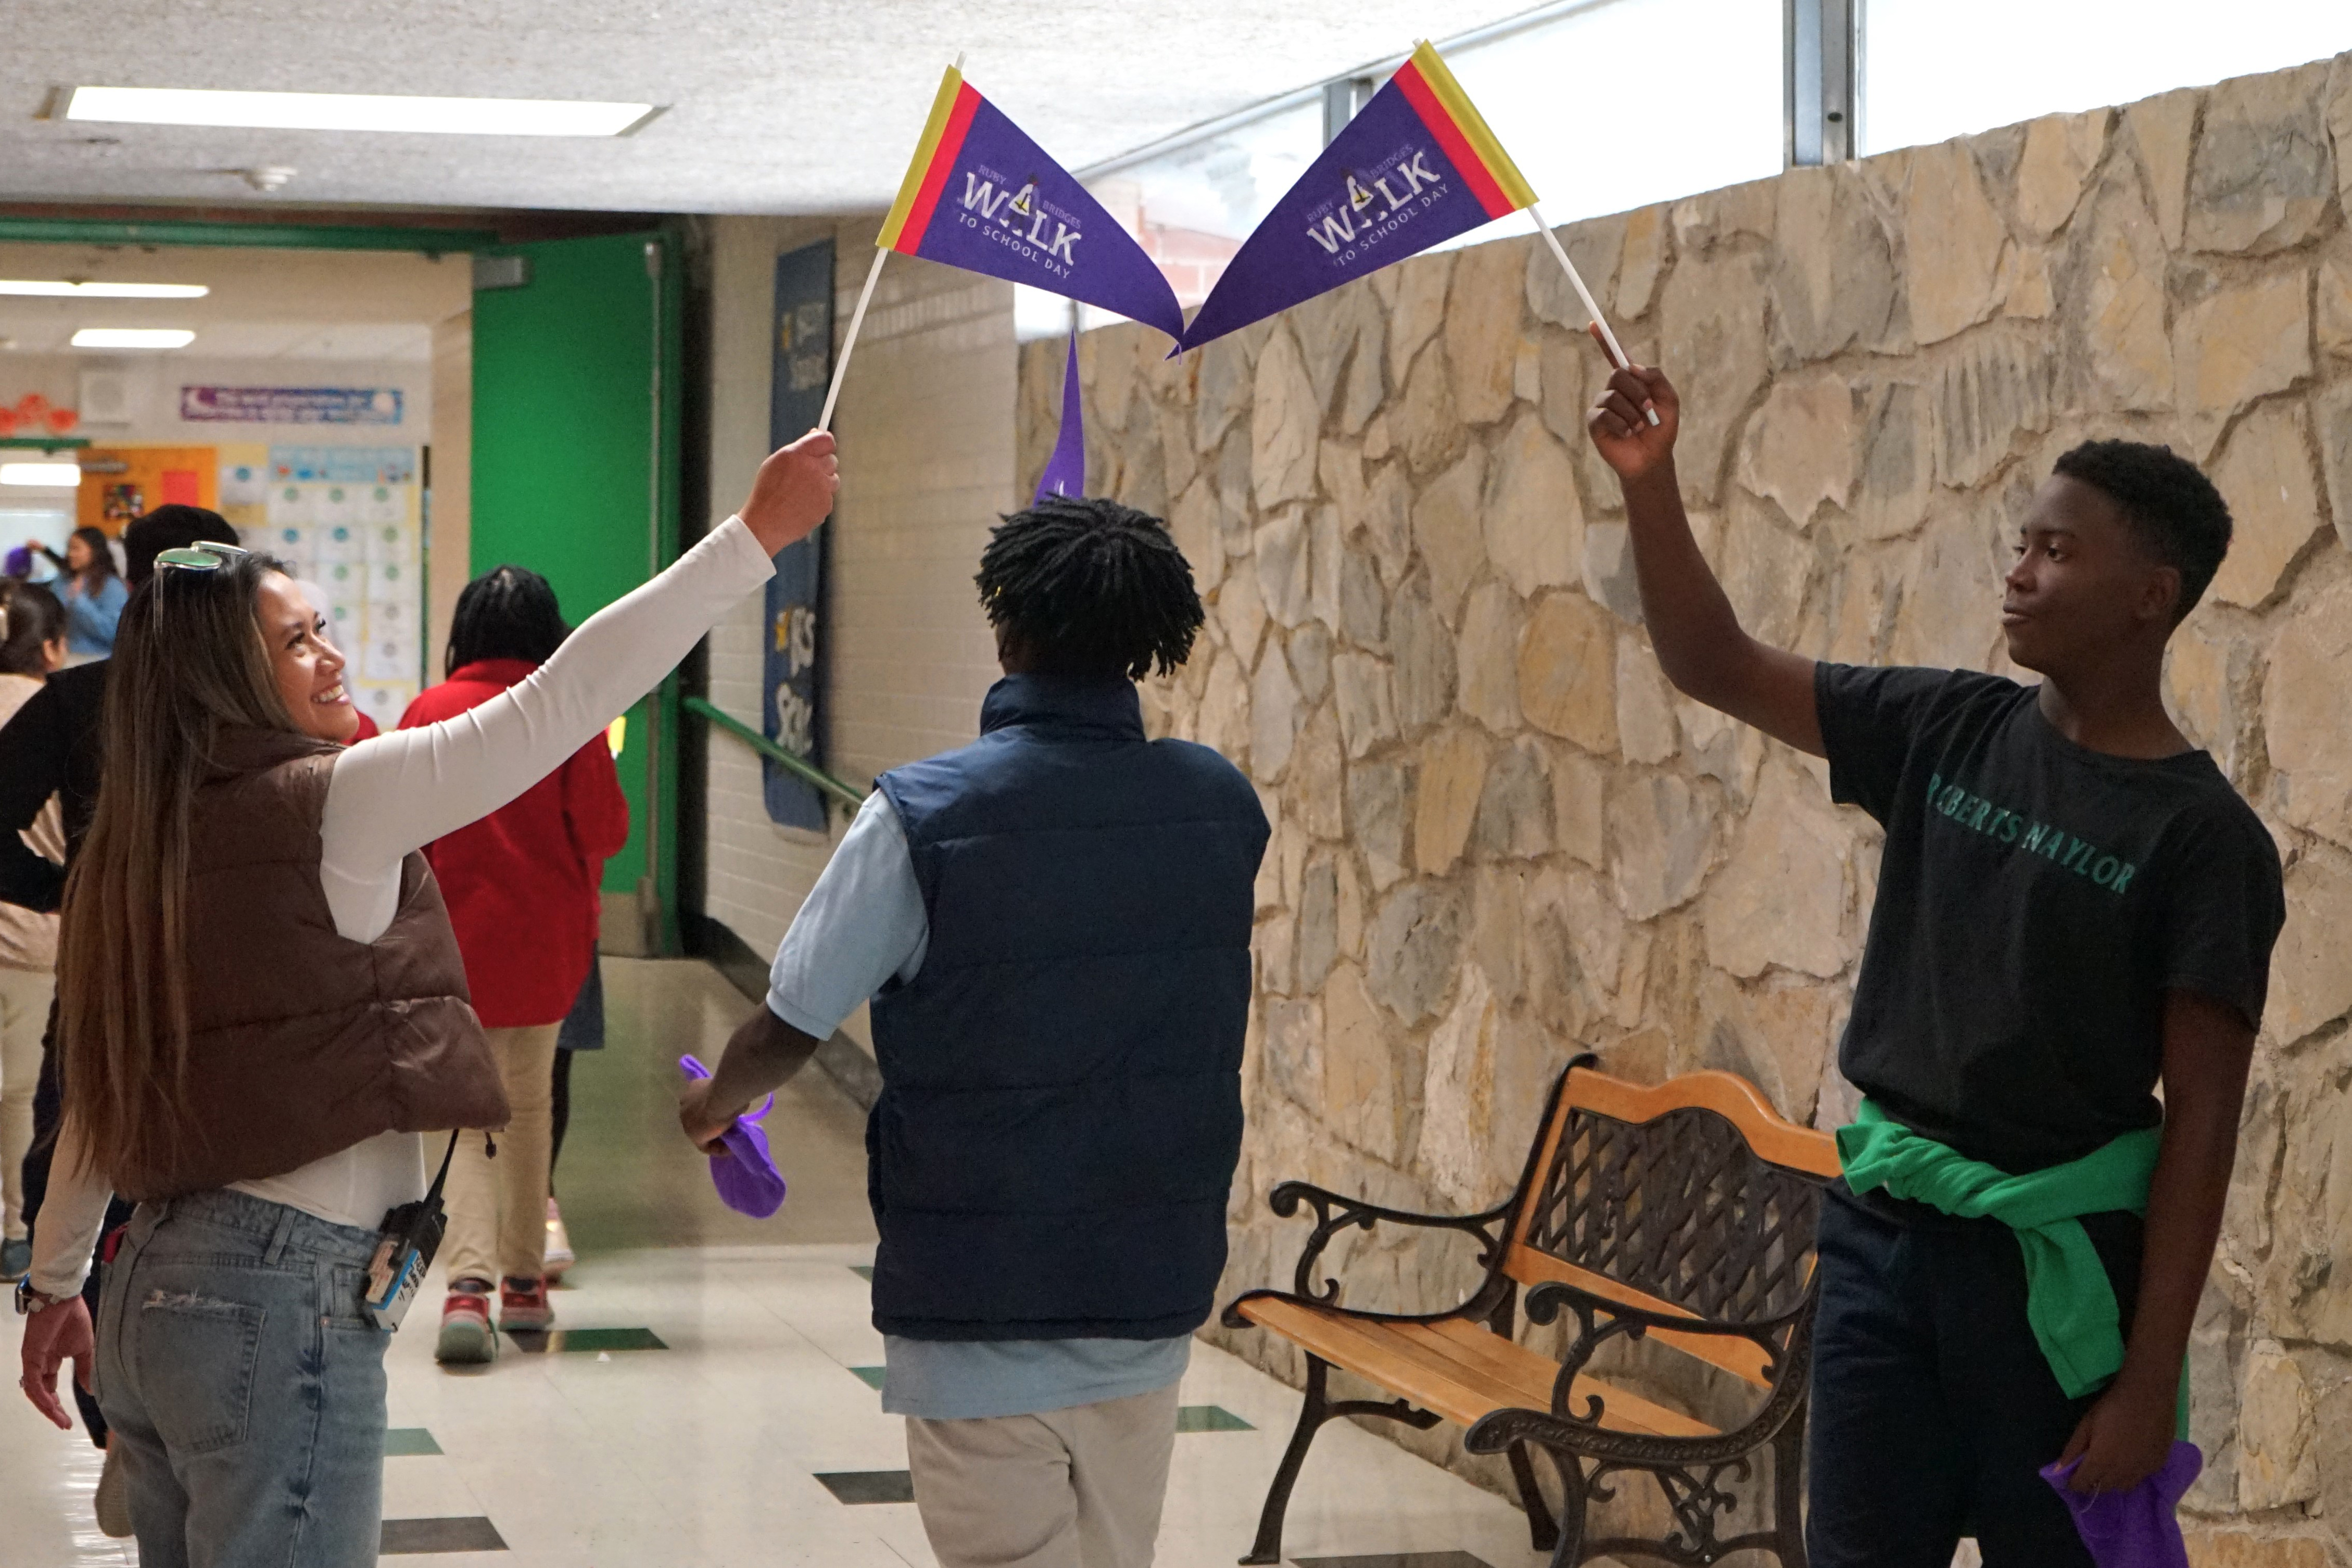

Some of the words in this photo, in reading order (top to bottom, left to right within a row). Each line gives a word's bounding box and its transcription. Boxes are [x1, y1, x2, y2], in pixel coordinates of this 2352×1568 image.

[964, 171, 1082, 266] WALK
[978, 165, 1007, 184] RUBY
[1042, 200, 1082, 230] BRIDGES
[1306, 150, 1441, 254] WALK
[1337, 250, 1356, 266] TO
[1359, 207, 1419, 250] SCHOOL
[1421, 183, 1448, 207] DAY
[959, 212, 977, 228] TO
[982, 225, 1038, 262] SCHOOL
[1044, 258, 1070, 279] DAY
[2021, 822, 2135, 894] NAYLOR
